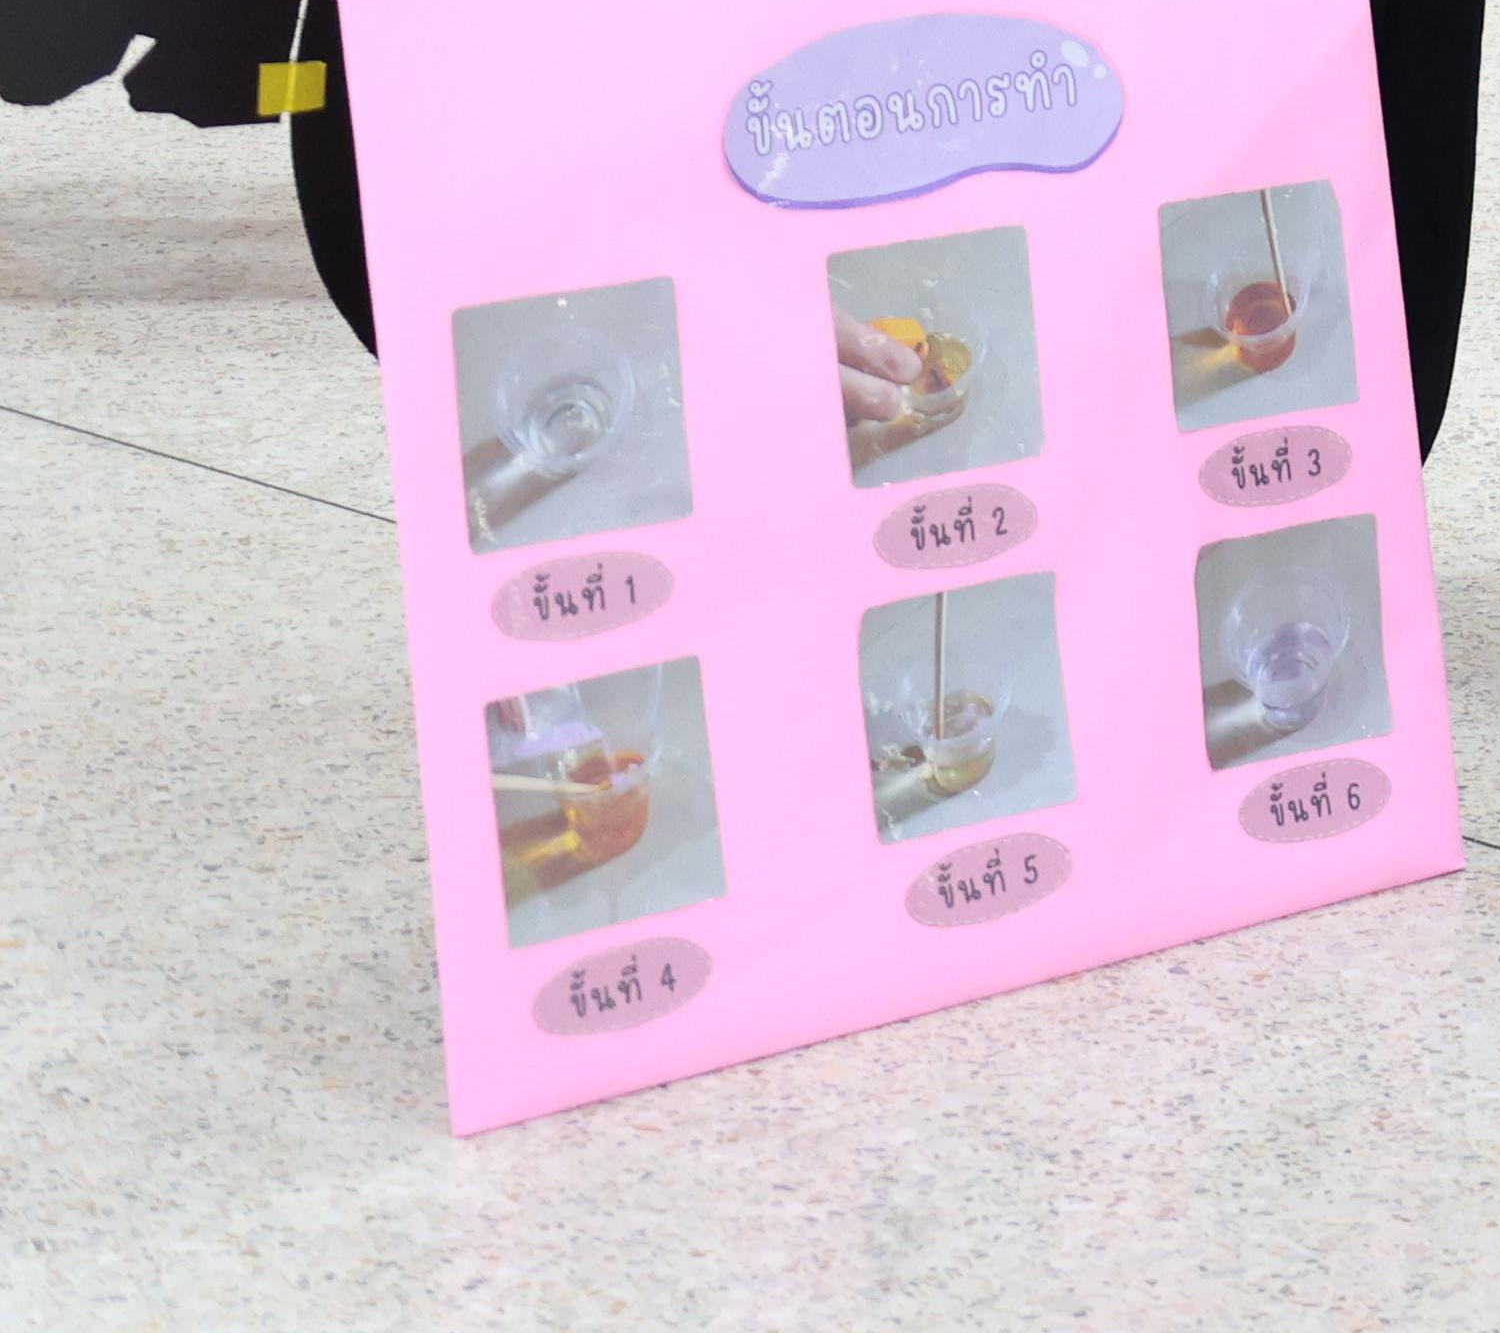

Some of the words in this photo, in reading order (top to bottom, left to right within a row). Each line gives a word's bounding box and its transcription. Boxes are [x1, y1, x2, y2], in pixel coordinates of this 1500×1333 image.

[746, 49, 1077, 156] ขั้นตอนการทำ
[1307, 448, 1322, 476] 3
[992, 506, 1008, 536] 2
[625, 574, 636, 605] 1
[1347, 782, 1361, 811] 6
[1023, 854, 1039, 884] 5
[660, 962, 676, 992] 4
